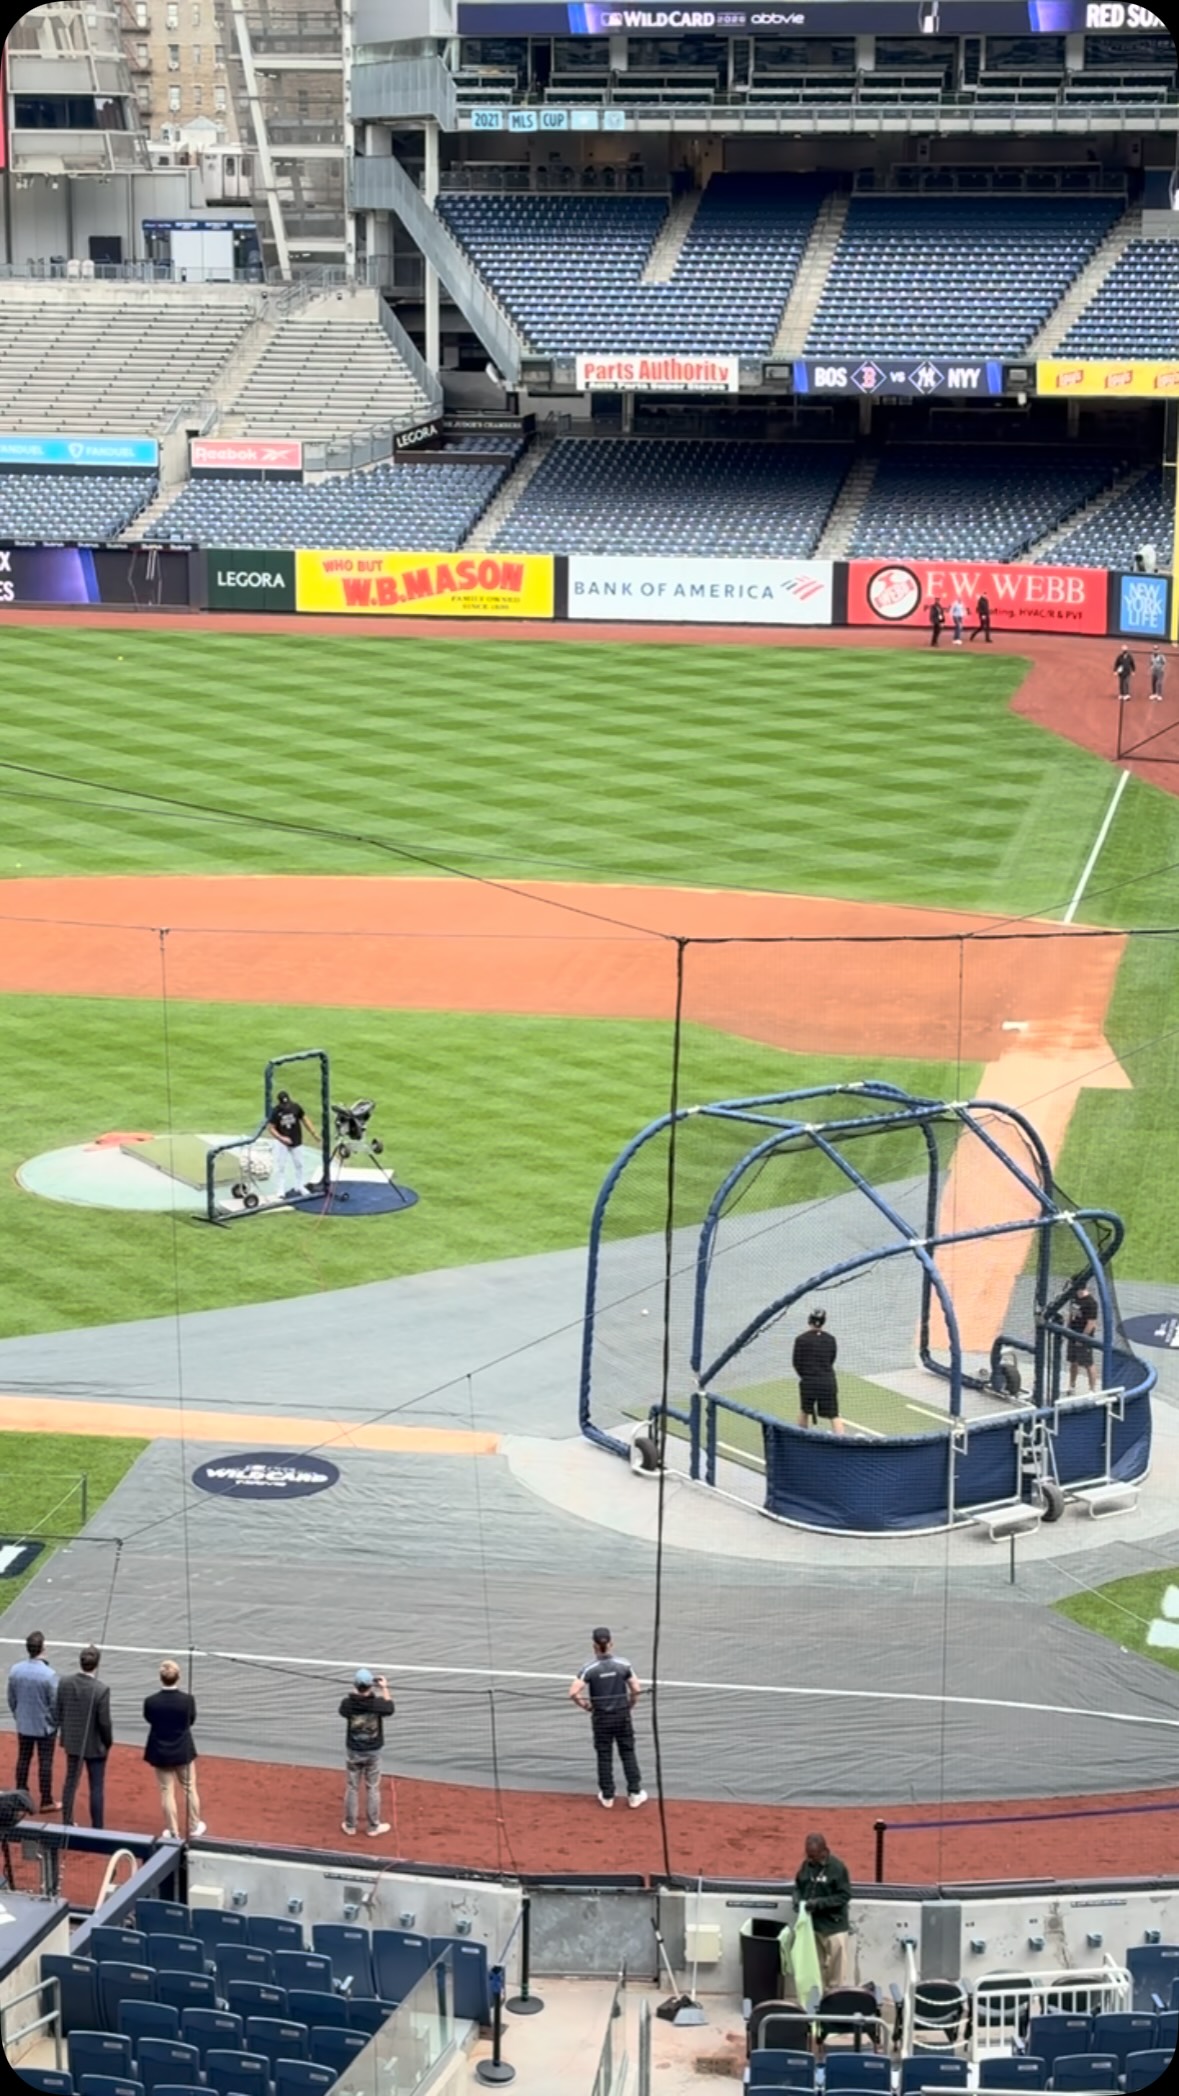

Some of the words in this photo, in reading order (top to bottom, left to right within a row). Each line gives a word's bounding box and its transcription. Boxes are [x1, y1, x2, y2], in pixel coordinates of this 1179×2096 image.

[751, 13, 805, 25] abbvie
[1086, 3, 1125, 28] RED
[474, 112, 499, 127] 2021
[512, 114, 533, 128] MLS
[543, 113, 565, 127] CUP
[584, 363, 634, 380] Parts
[638, 359, 729, 381] Authority
[814, 367, 848, 387] BOS
[947, 368, 981, 388] NYY
[396, 425, 438, 448] LEGORA
[195, 446, 257, 462] Reebok
[322, 559, 354, 573] WHO
[357, 560, 383, 573] BUT
[217, 571, 286, 588] LEGORA
[991, 573, 1086, 604] WEBB
[574, 581, 633, 596] BANK
[641, 582, 668, 597] OF
[674, 583, 775, 600] AMERICA
[1129, 582, 1161, 601] NEW
[1124, 595, 1163, 615] YORK
[1128, 609, 1159, 628] LIFE
